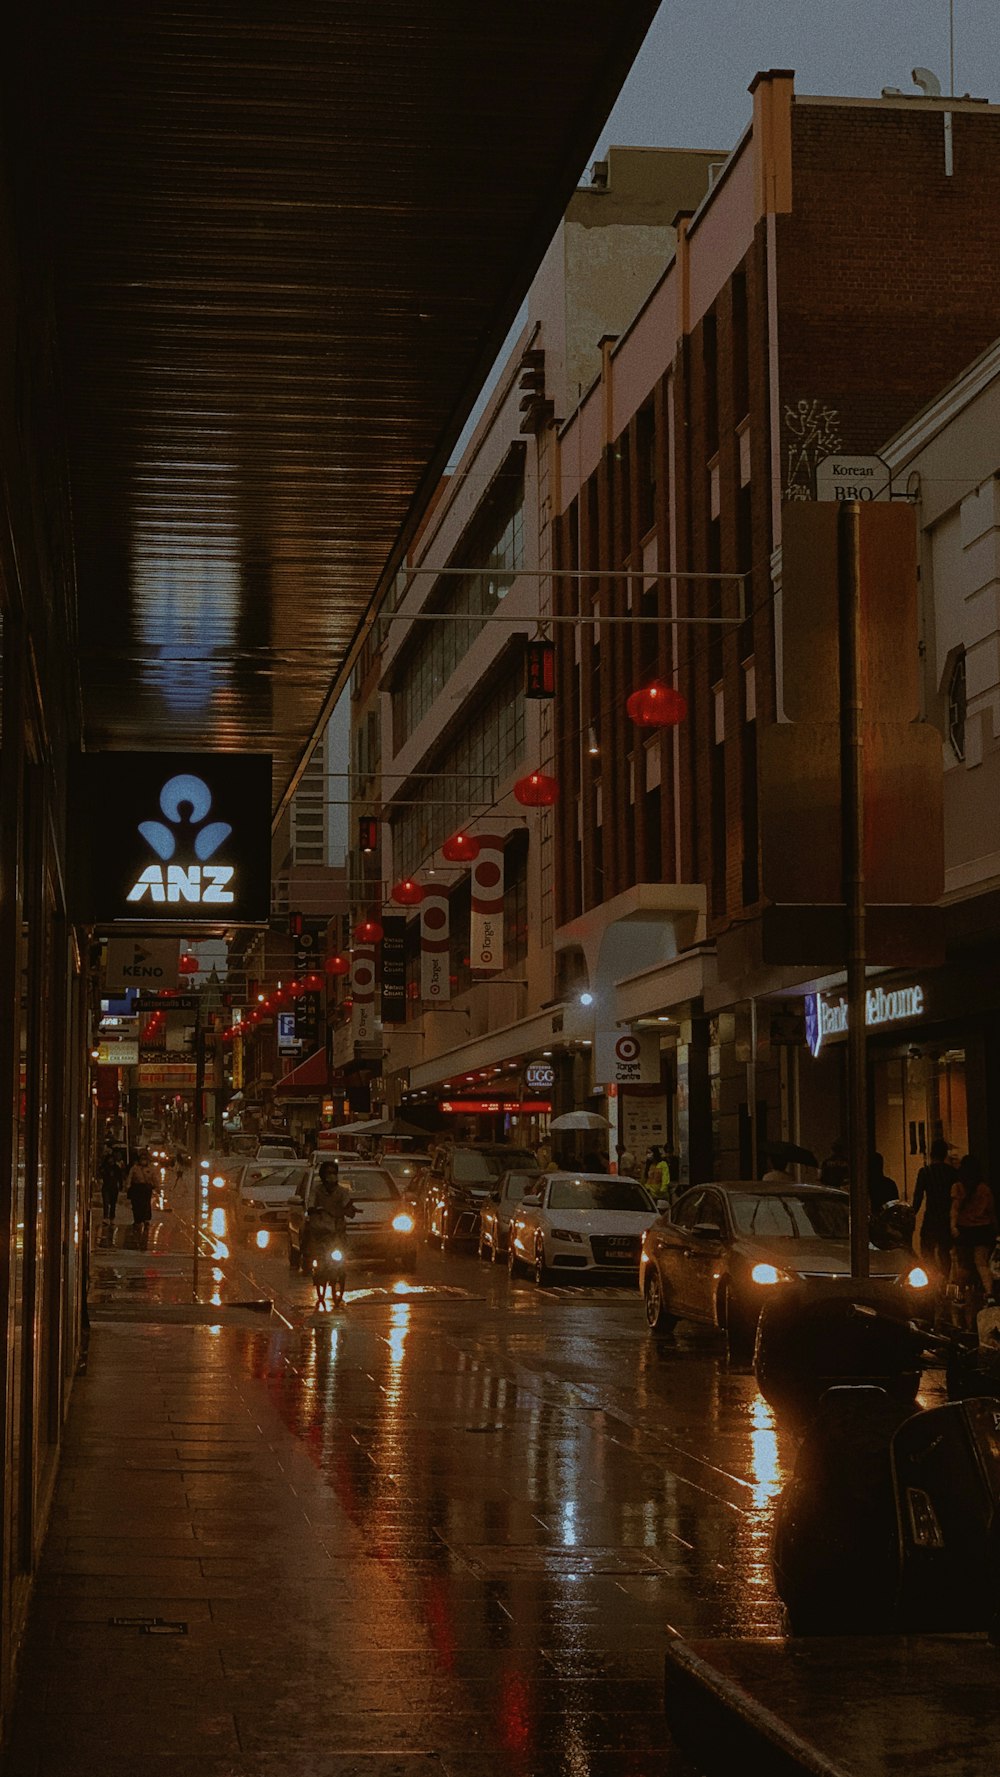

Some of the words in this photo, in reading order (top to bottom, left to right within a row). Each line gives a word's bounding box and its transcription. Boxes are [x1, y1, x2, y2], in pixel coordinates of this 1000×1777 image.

[833, 464, 874, 476] Korean
[125, 864, 235, 904] ANZ
[482, 921, 495, 950] Target
[123, 965, 163, 977] KENO
[431, 959, 441, 983] Target
[359, 1008, 367, 1027] Target
[822, 998, 848, 1034] Bank
[527, 1070, 554, 1082] UGG
[615, 1062, 641, 1073] Target
